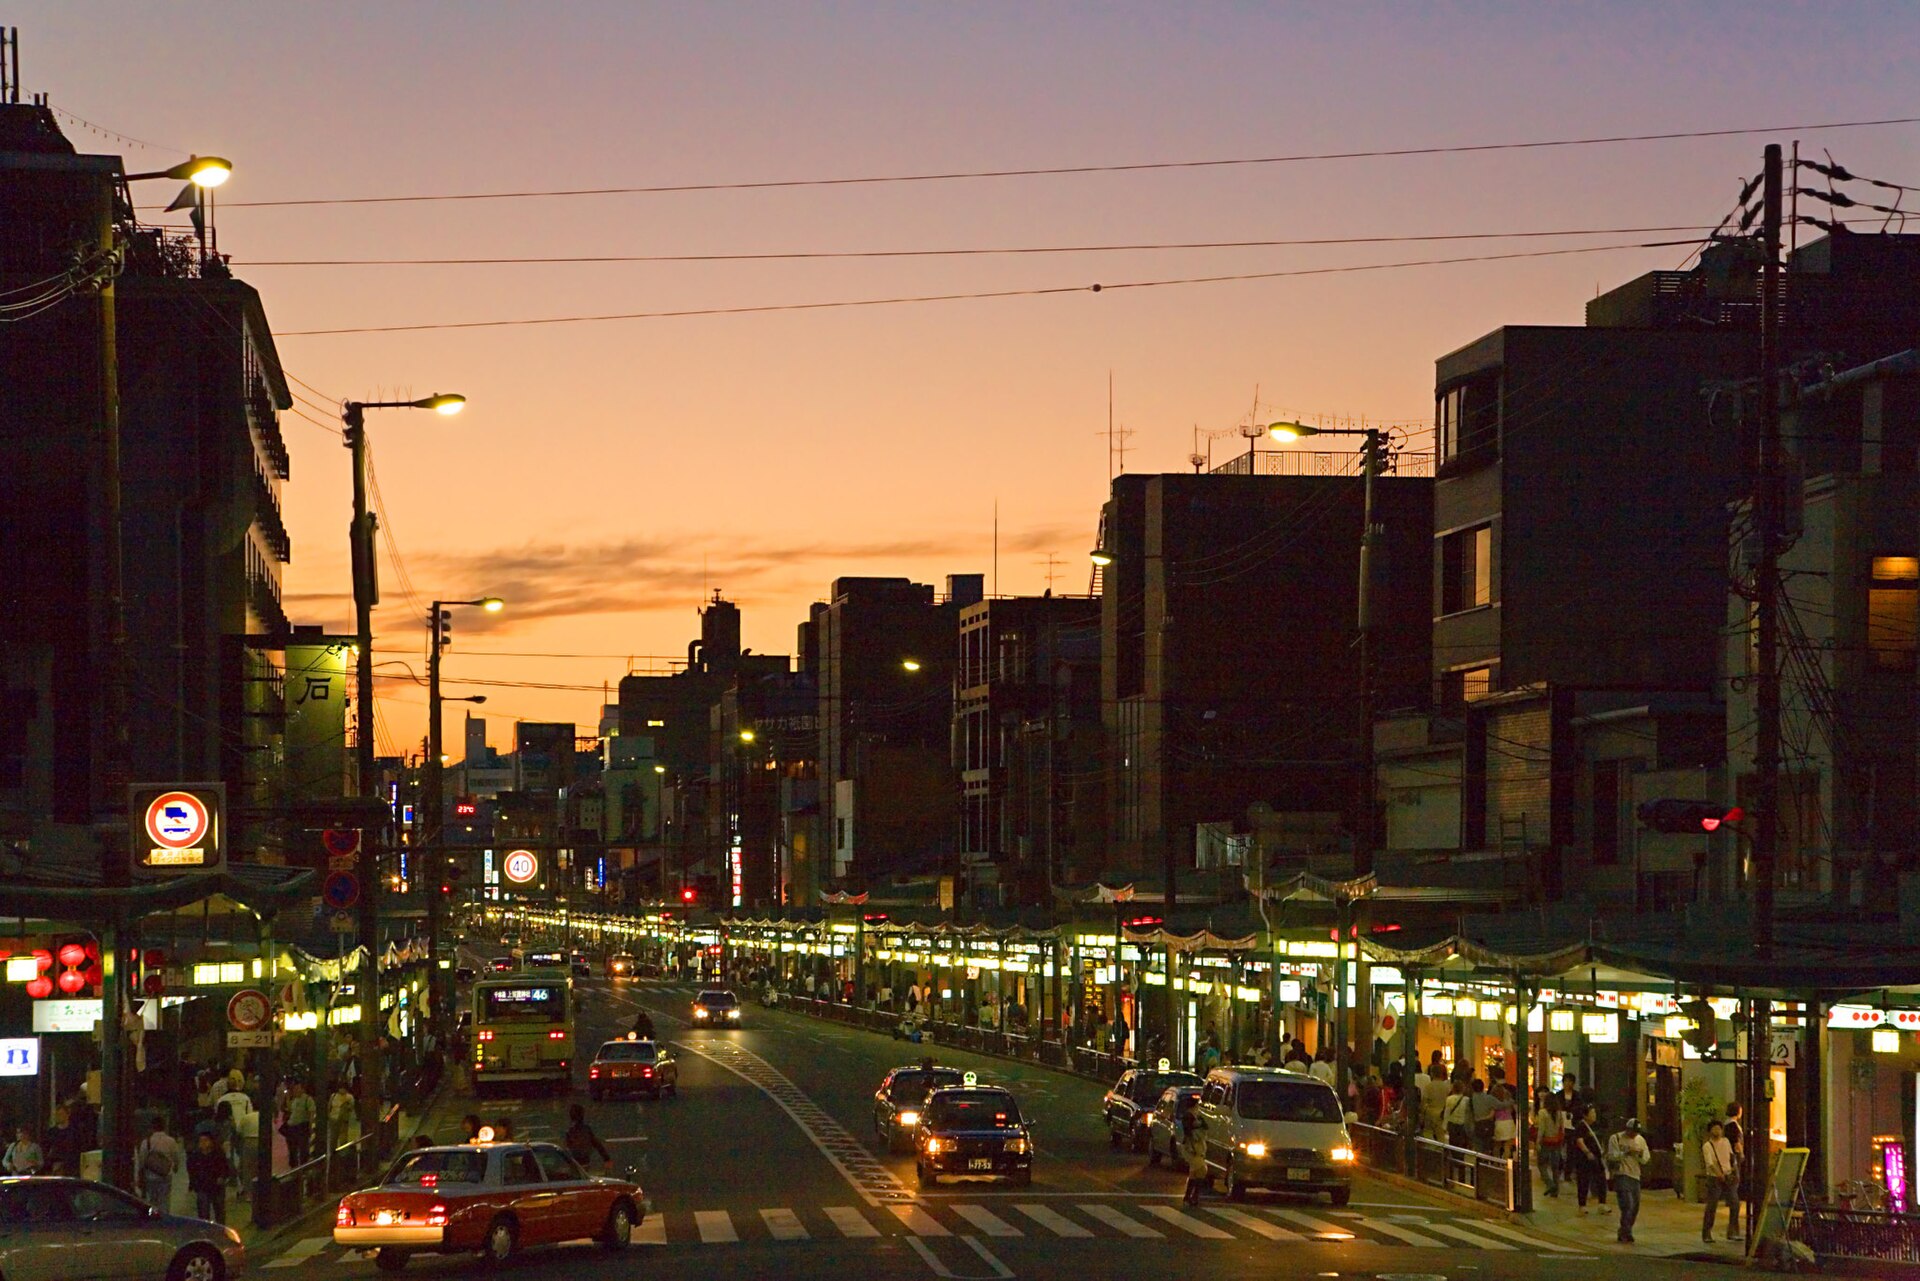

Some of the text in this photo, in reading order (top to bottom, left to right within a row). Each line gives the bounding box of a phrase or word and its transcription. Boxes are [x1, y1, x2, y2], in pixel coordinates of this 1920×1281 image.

[296, 676, 331, 704] 石
[513, 860, 529, 873] 40
[533, 989, 549, 1000] 46
